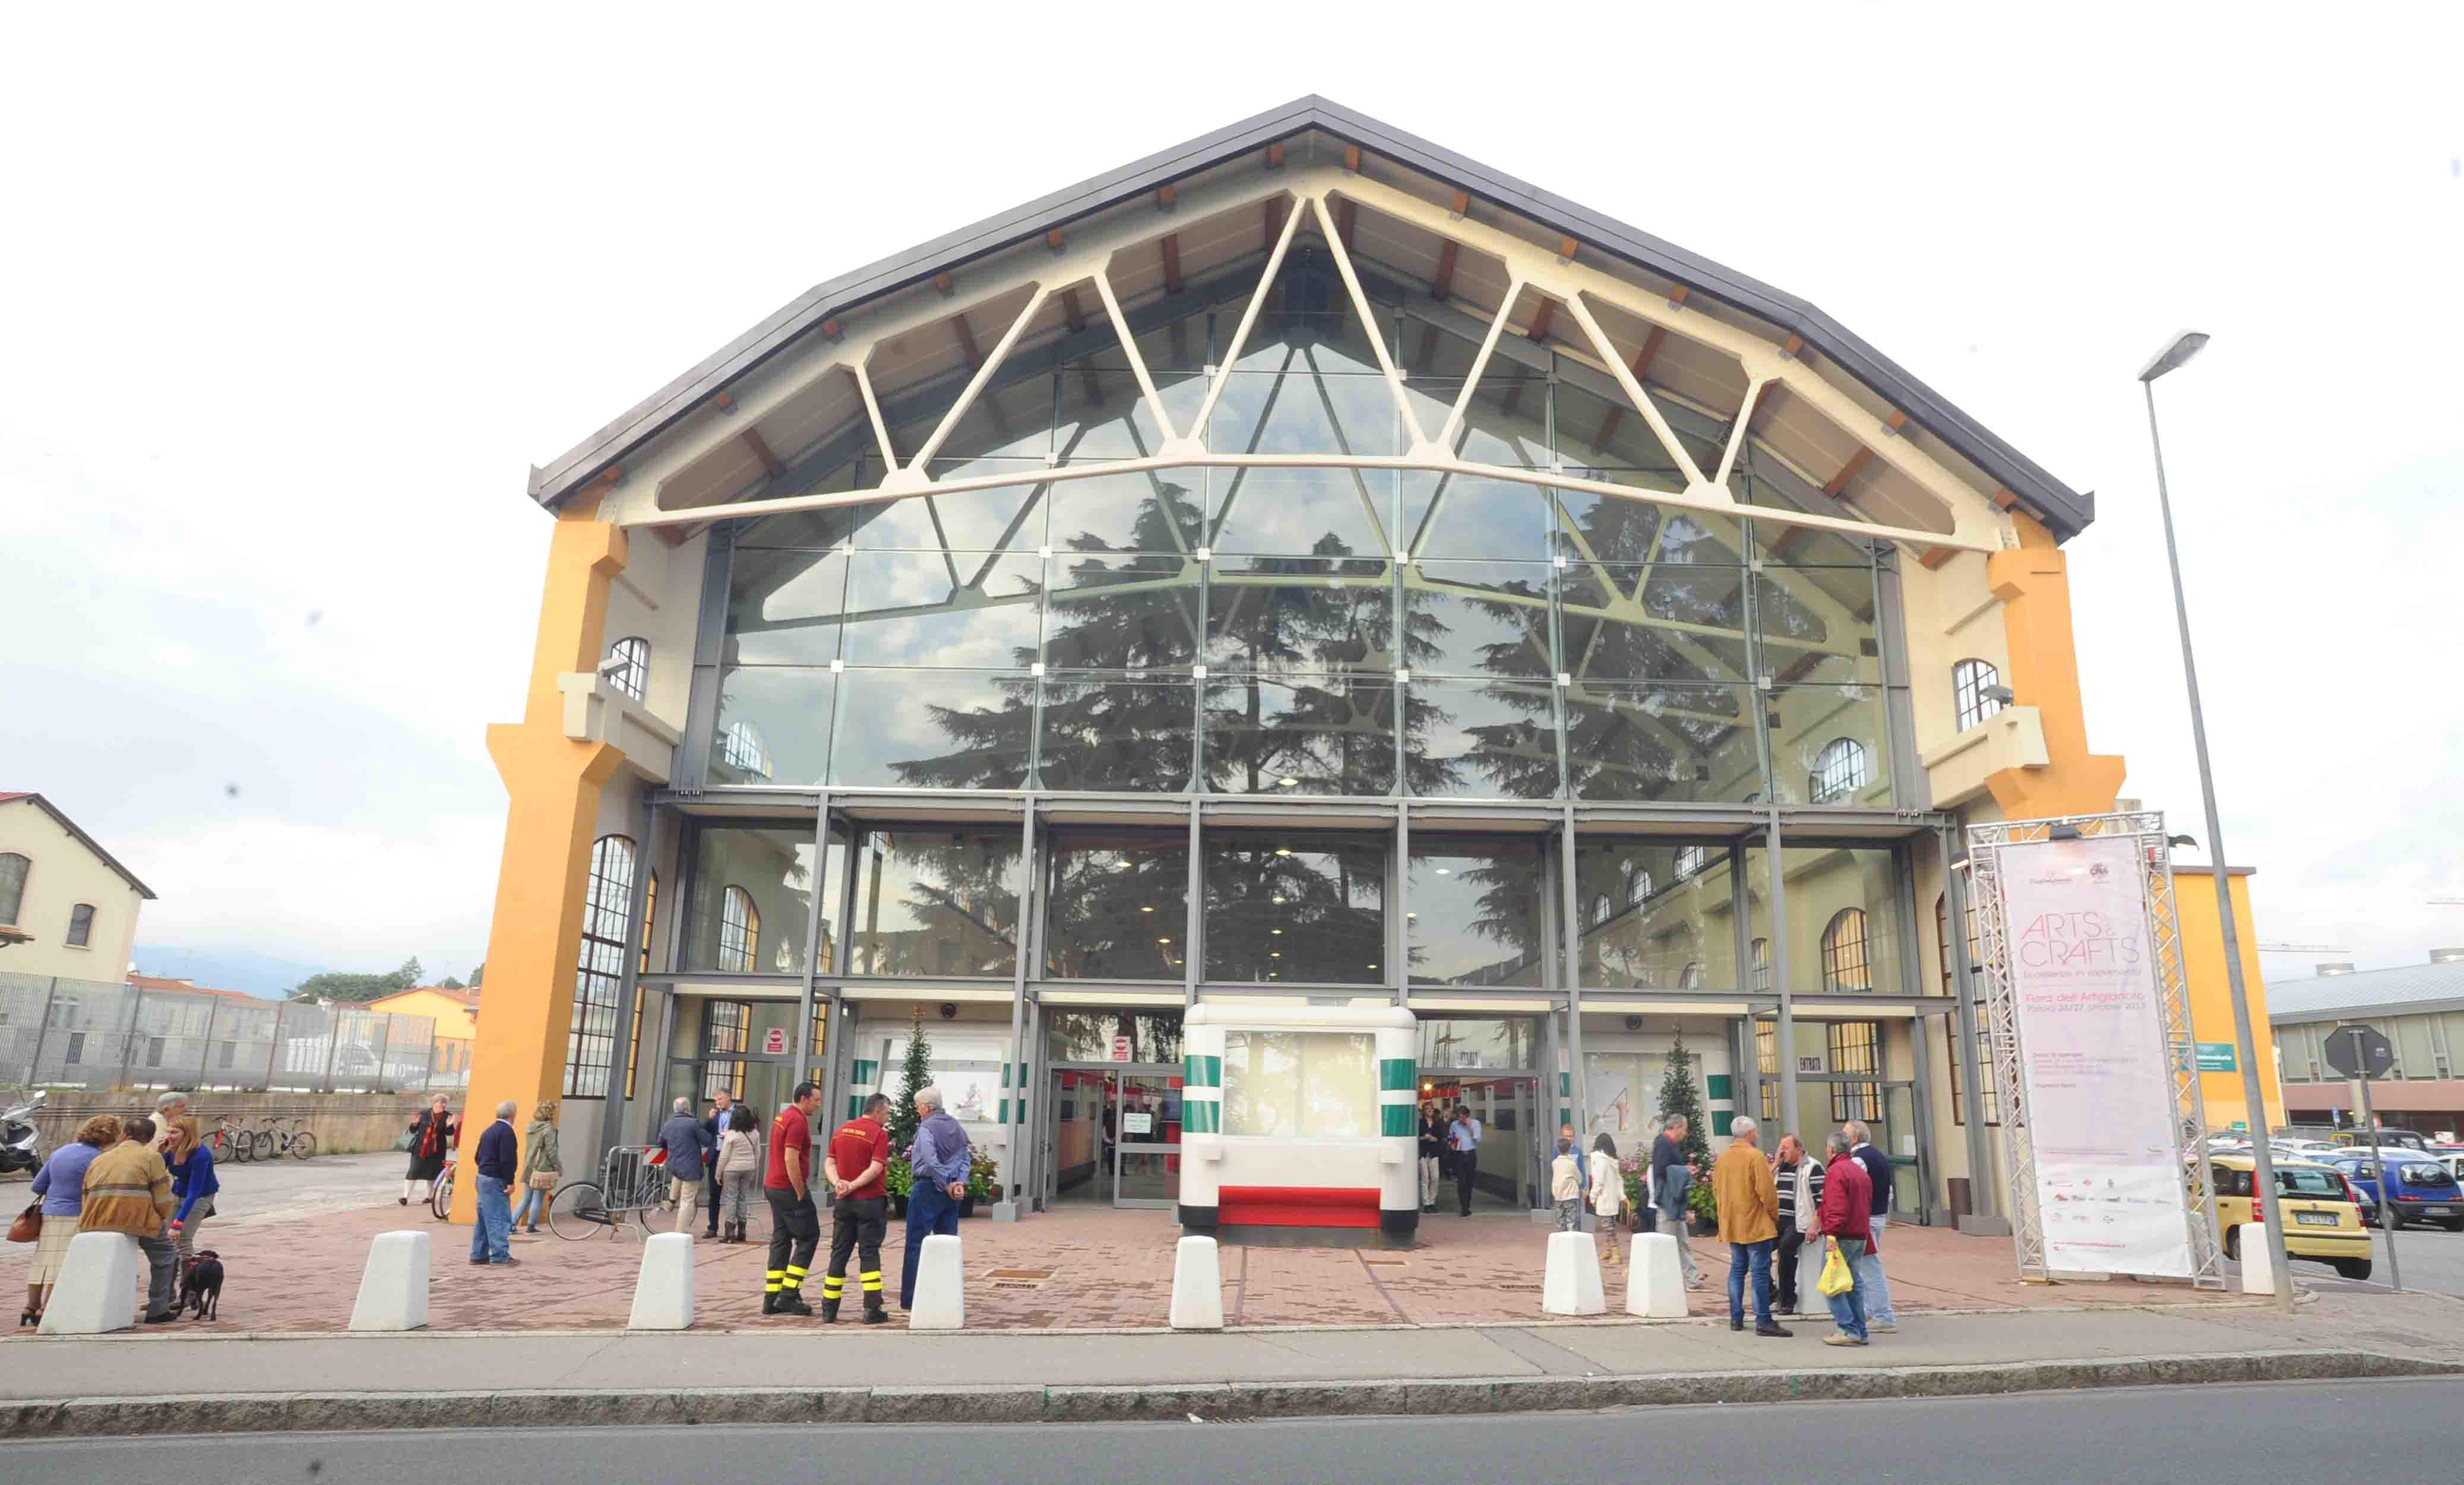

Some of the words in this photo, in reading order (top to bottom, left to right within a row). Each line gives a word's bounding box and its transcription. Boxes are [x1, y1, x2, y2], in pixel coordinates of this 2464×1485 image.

[2020, 911, 2102, 941] ARTS
[2020, 936, 2140, 968] CRAFTS
[2025, 993, 2053, 1002] Fiera
